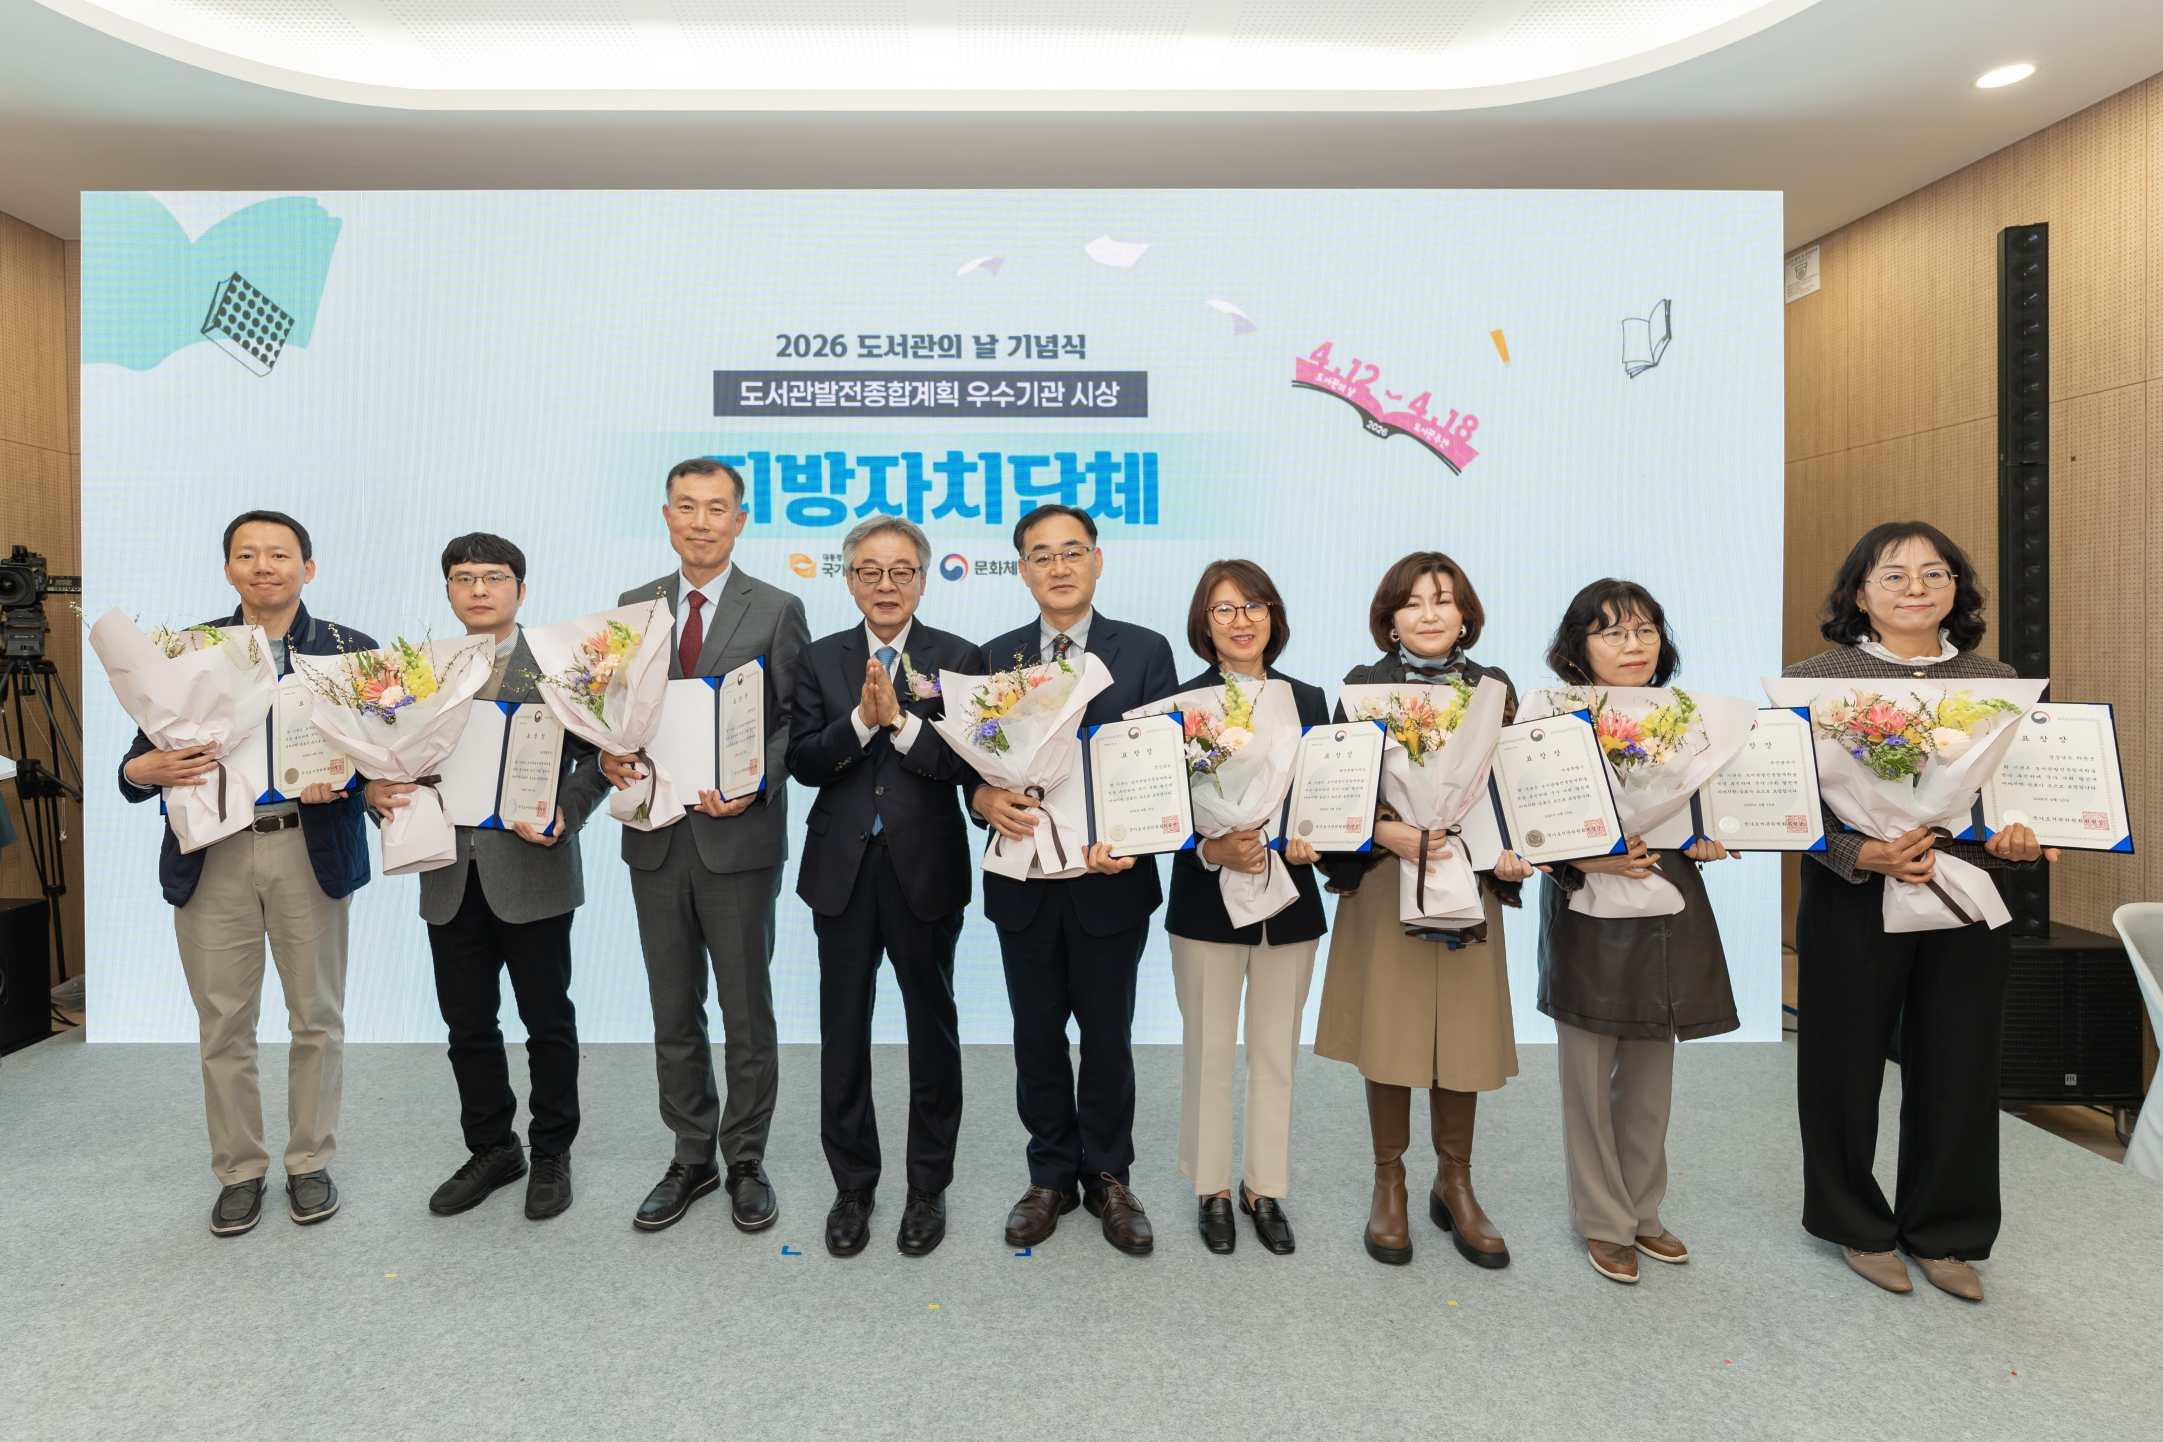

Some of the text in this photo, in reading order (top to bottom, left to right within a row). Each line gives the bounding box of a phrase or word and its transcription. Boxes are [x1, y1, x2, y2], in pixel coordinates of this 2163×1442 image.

[776, 334, 1087, 360] 2026 도서관의 날 기념식
[740, 379, 1120, 408] 도서관발전종합계획 우수기관 시상
[1366, 420, 1389, 436] 2026
[974, 560, 1020, 576] 문화체
